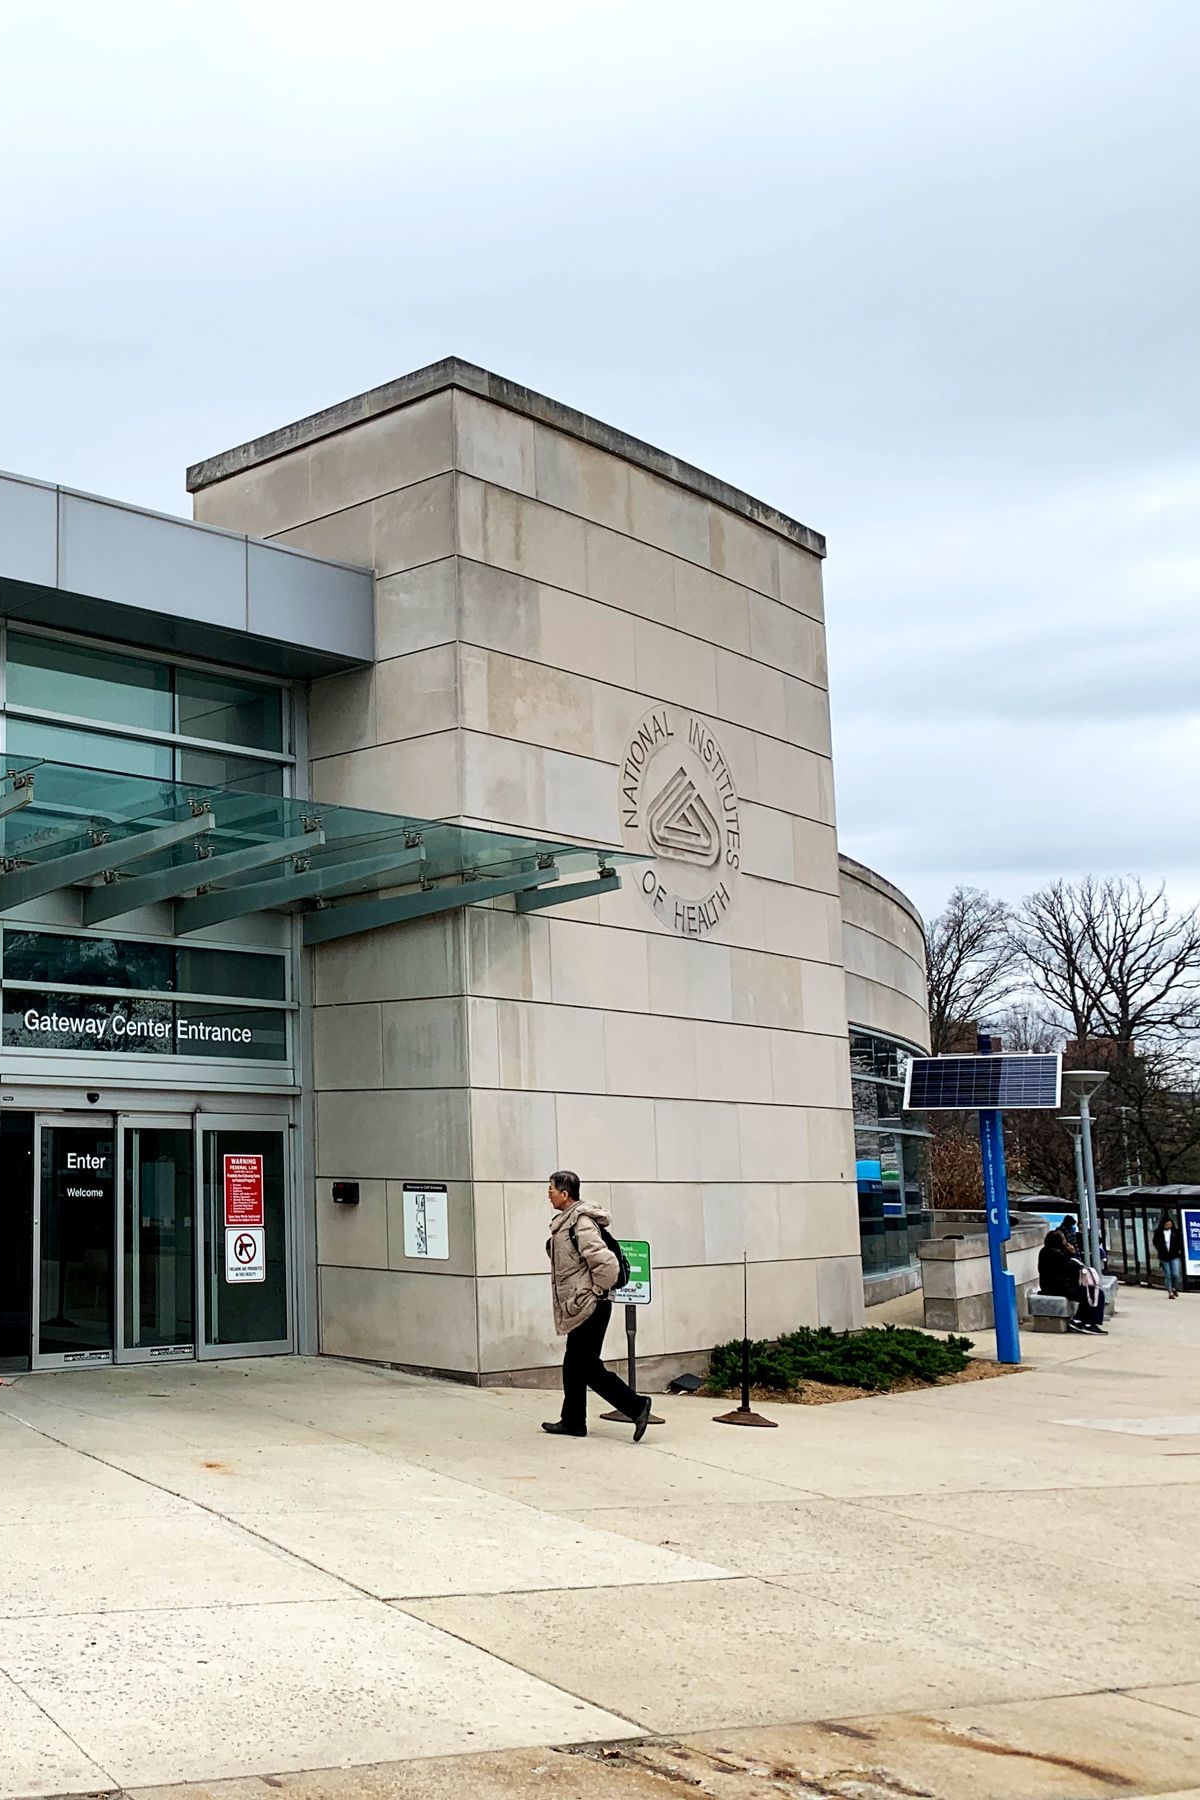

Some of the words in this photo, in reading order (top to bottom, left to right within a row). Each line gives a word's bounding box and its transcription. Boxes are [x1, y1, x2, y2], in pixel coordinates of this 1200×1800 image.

[623, 711, 674, 828] NATIONAL
[688, 718, 741, 870] INSTITUTES
[642, 870, 667, 907] OF
[674, 882, 731, 933] HEALTH
[24, 1009, 107, 1038] Gateway
[112, 1015, 172, 1038] Center
[177, 1020, 252, 1043] Entrance
[67, 1152, 106, 1169] Enter
[66, 1187, 104, 1198] Welcome
